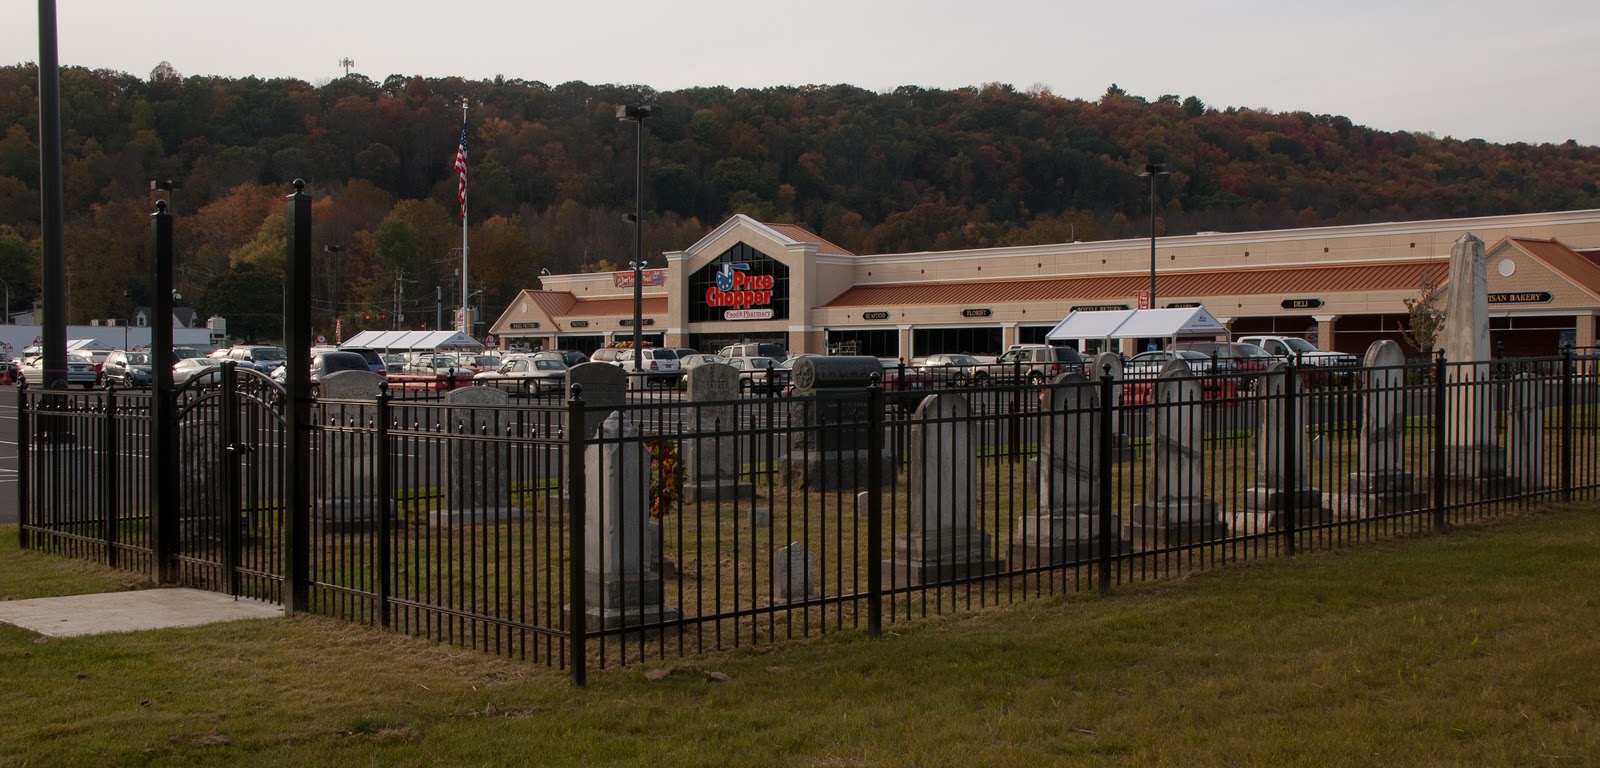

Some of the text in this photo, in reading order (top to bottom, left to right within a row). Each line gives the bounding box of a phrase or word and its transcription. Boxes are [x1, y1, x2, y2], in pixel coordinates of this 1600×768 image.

[733, 271, 774, 290] Price
[706, 286, 773, 309] Chopper
[1488, 293, 1541, 302] ISAN BAKERY
